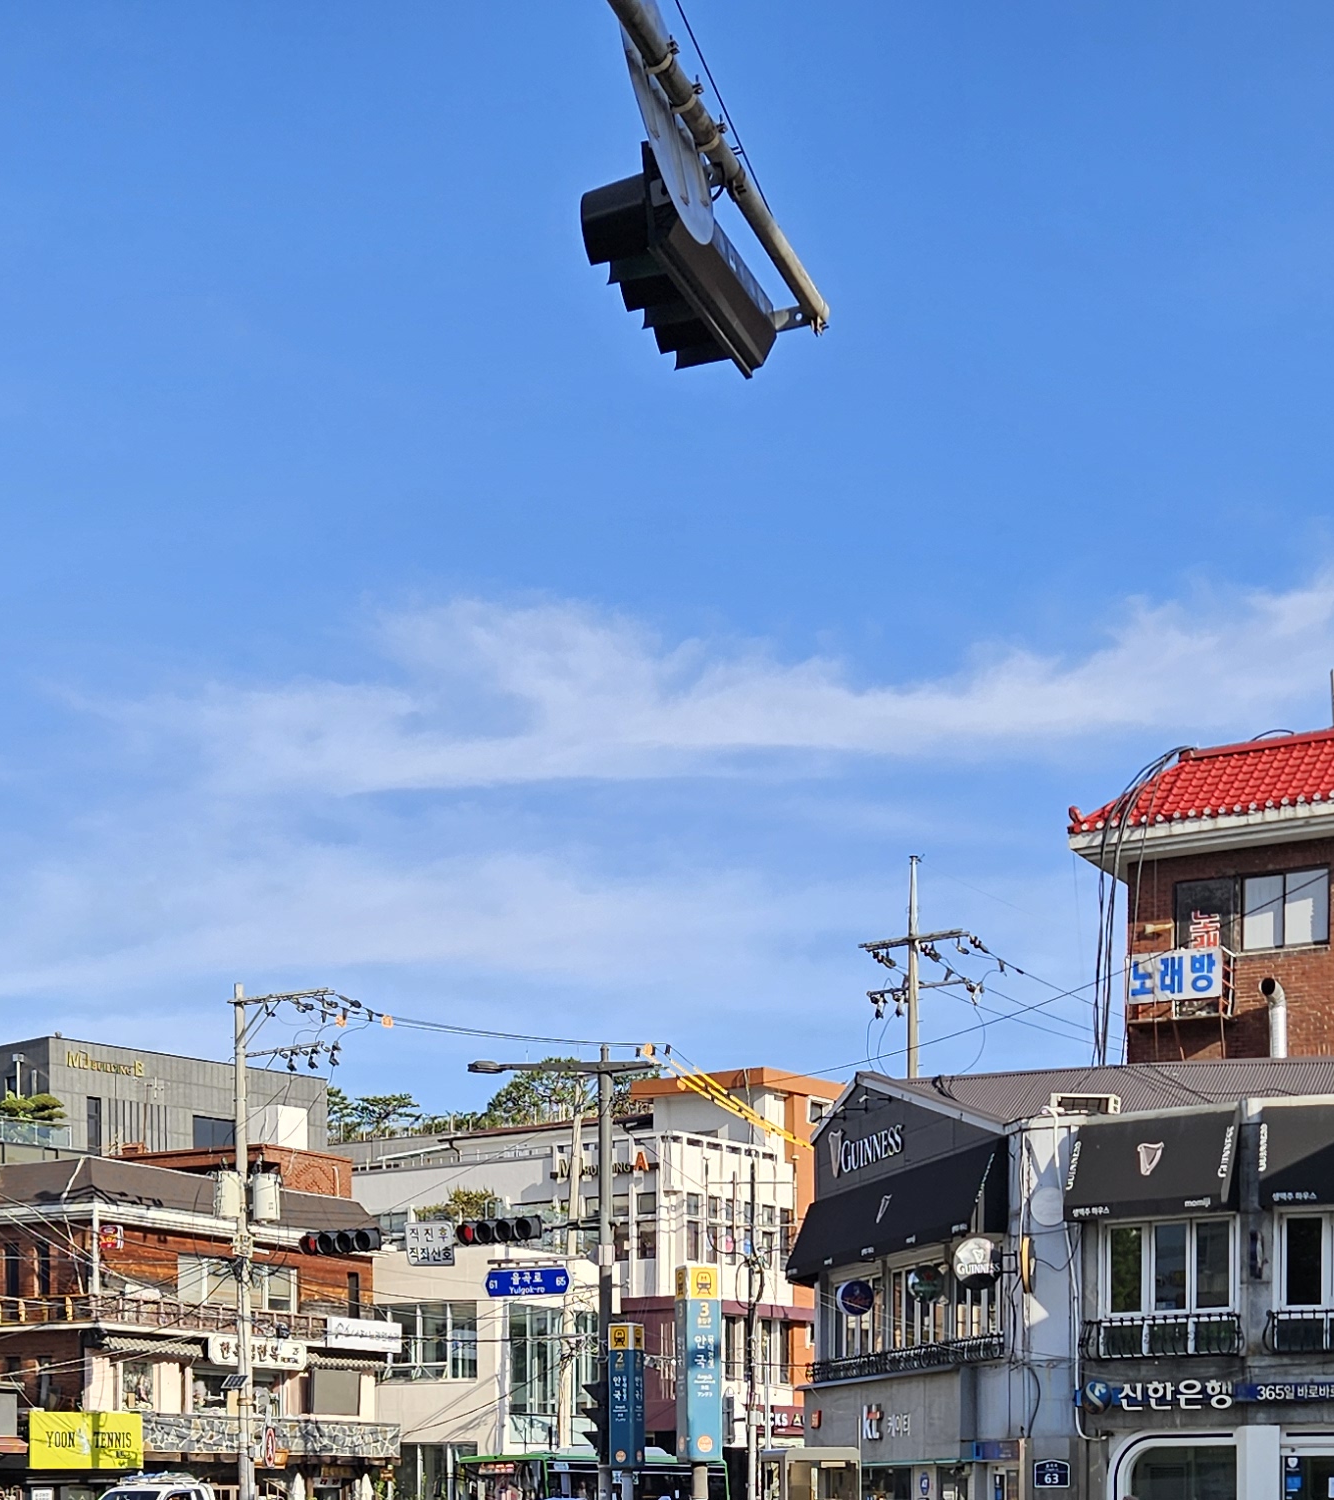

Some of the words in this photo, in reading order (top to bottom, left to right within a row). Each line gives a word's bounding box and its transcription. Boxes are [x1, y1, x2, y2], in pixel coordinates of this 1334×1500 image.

[1130, 953, 1216, 996] 노래방
[134, 1060, 145, 1077] B
[840, 1125, 904, 1173] GUINNESS
[634, 1151, 649, 1171] A
[409, 1227, 448, 1242] 직진후
[409, 1247, 453, 1262] 직좌신호
[957, 1263, 1001, 1275] GUINNESS
[489, 1279, 498, 1289] 61
[511, 1272, 543, 1285] 율곡로
[555, 1276, 566, 1286] 65
[509, 1286, 545, 1295] Yulgok-ro
[700, 1302, 709, 1316] 3
[617, 1352, 624, 1362] 2
[694, 1335, 707, 1368] 안국
[1118, 1379, 1233, 1411] 신한은행
[1256, 1385, 1295, 1400] 365일
[863, 1404, 882, 1439] kt
[887, 1413, 911, 1437] 케이티
[46, 1431, 75, 1448] YOON
[93, 1431, 132, 1449] TENNIS
[1044, 1473, 1059, 1484] 63
